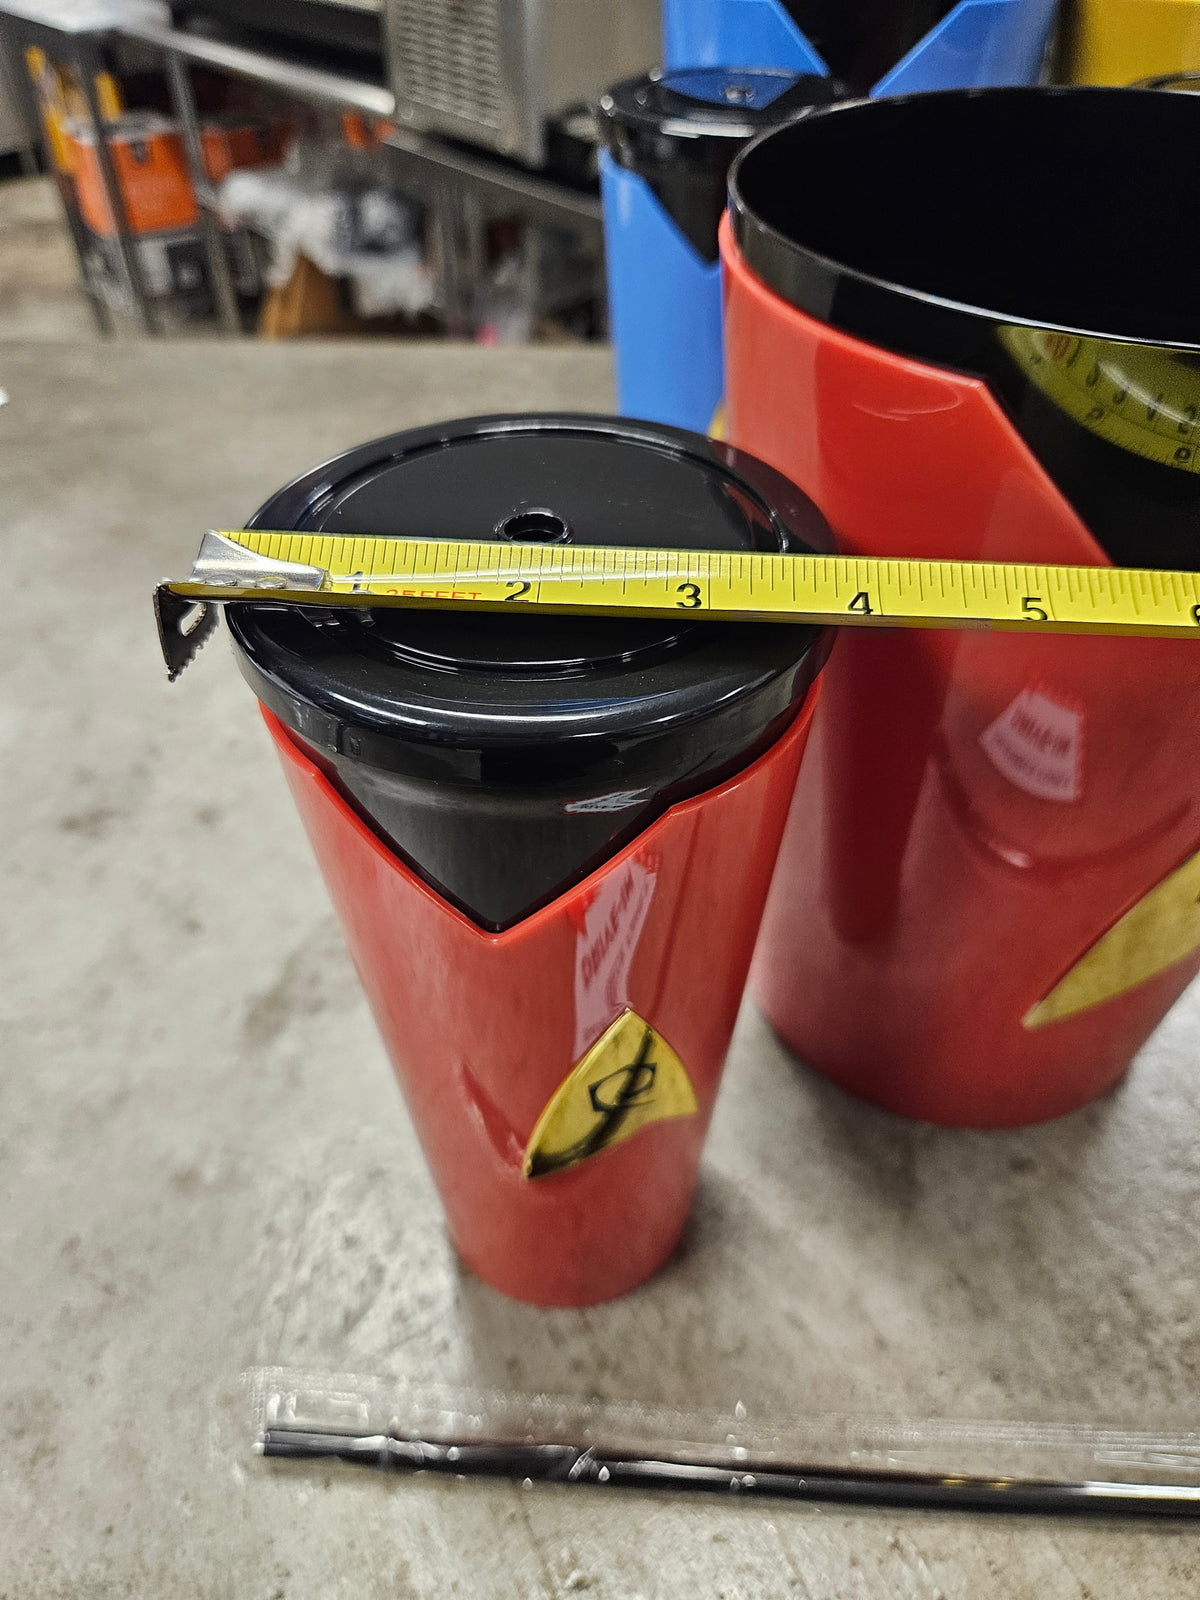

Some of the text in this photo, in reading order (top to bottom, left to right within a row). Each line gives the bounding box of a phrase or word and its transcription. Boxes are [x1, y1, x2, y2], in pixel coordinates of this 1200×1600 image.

[346, 571, 1048, 621] 1 2 3 4 5
